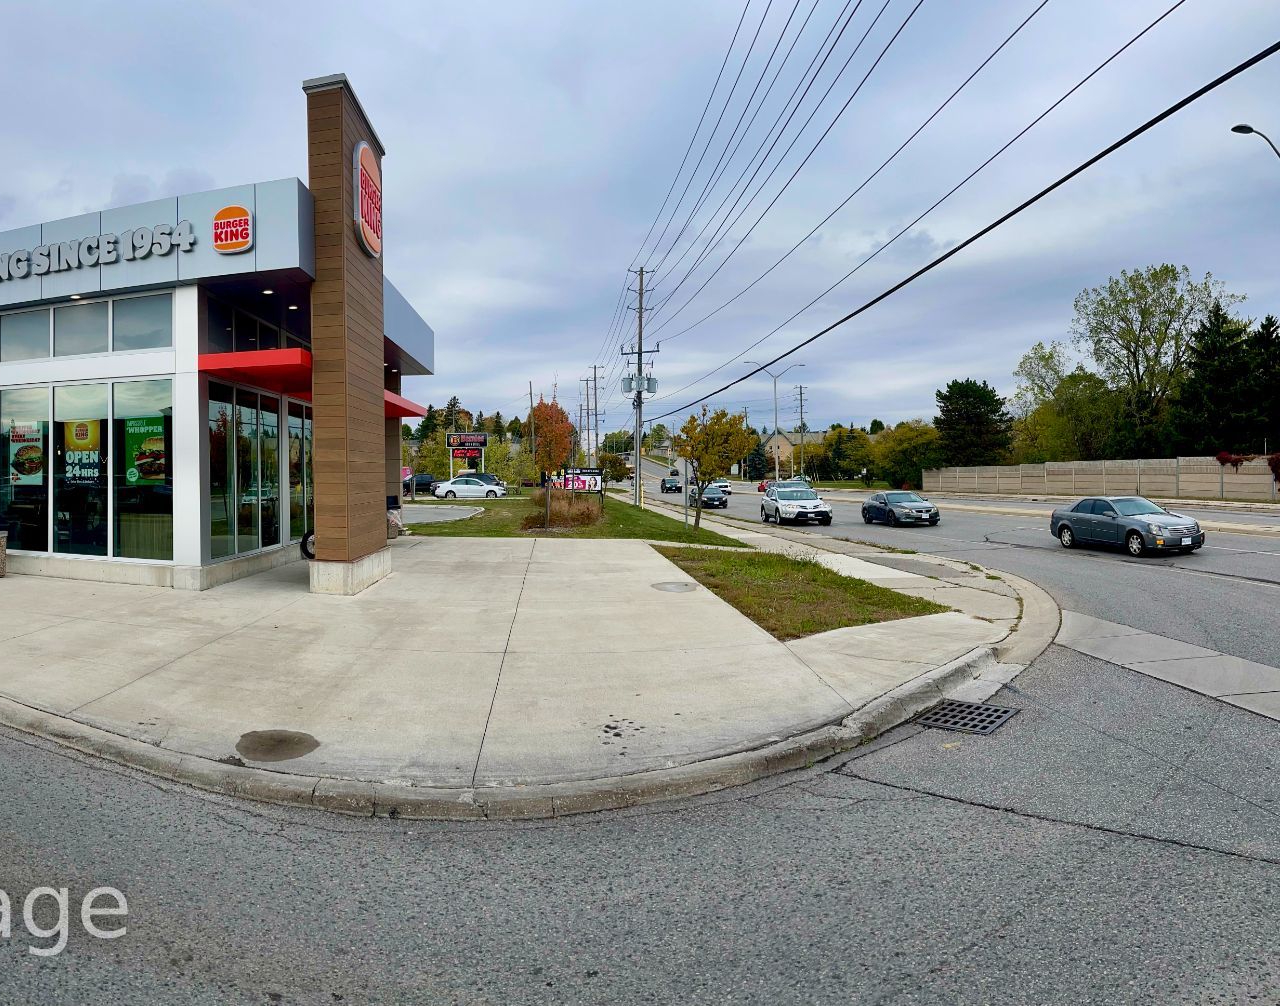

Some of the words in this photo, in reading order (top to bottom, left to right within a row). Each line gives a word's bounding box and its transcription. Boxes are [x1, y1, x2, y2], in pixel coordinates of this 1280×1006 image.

[360, 167, 381, 213] BURGER
[213, 218, 250, 230] BURGER
[360, 189, 381, 240] KING
[32, 233, 119, 276] SINCE
[121, 220, 197, 261] 1954
[213, 228, 250, 243] KING
[65, 451, 99, 463] OPEN
